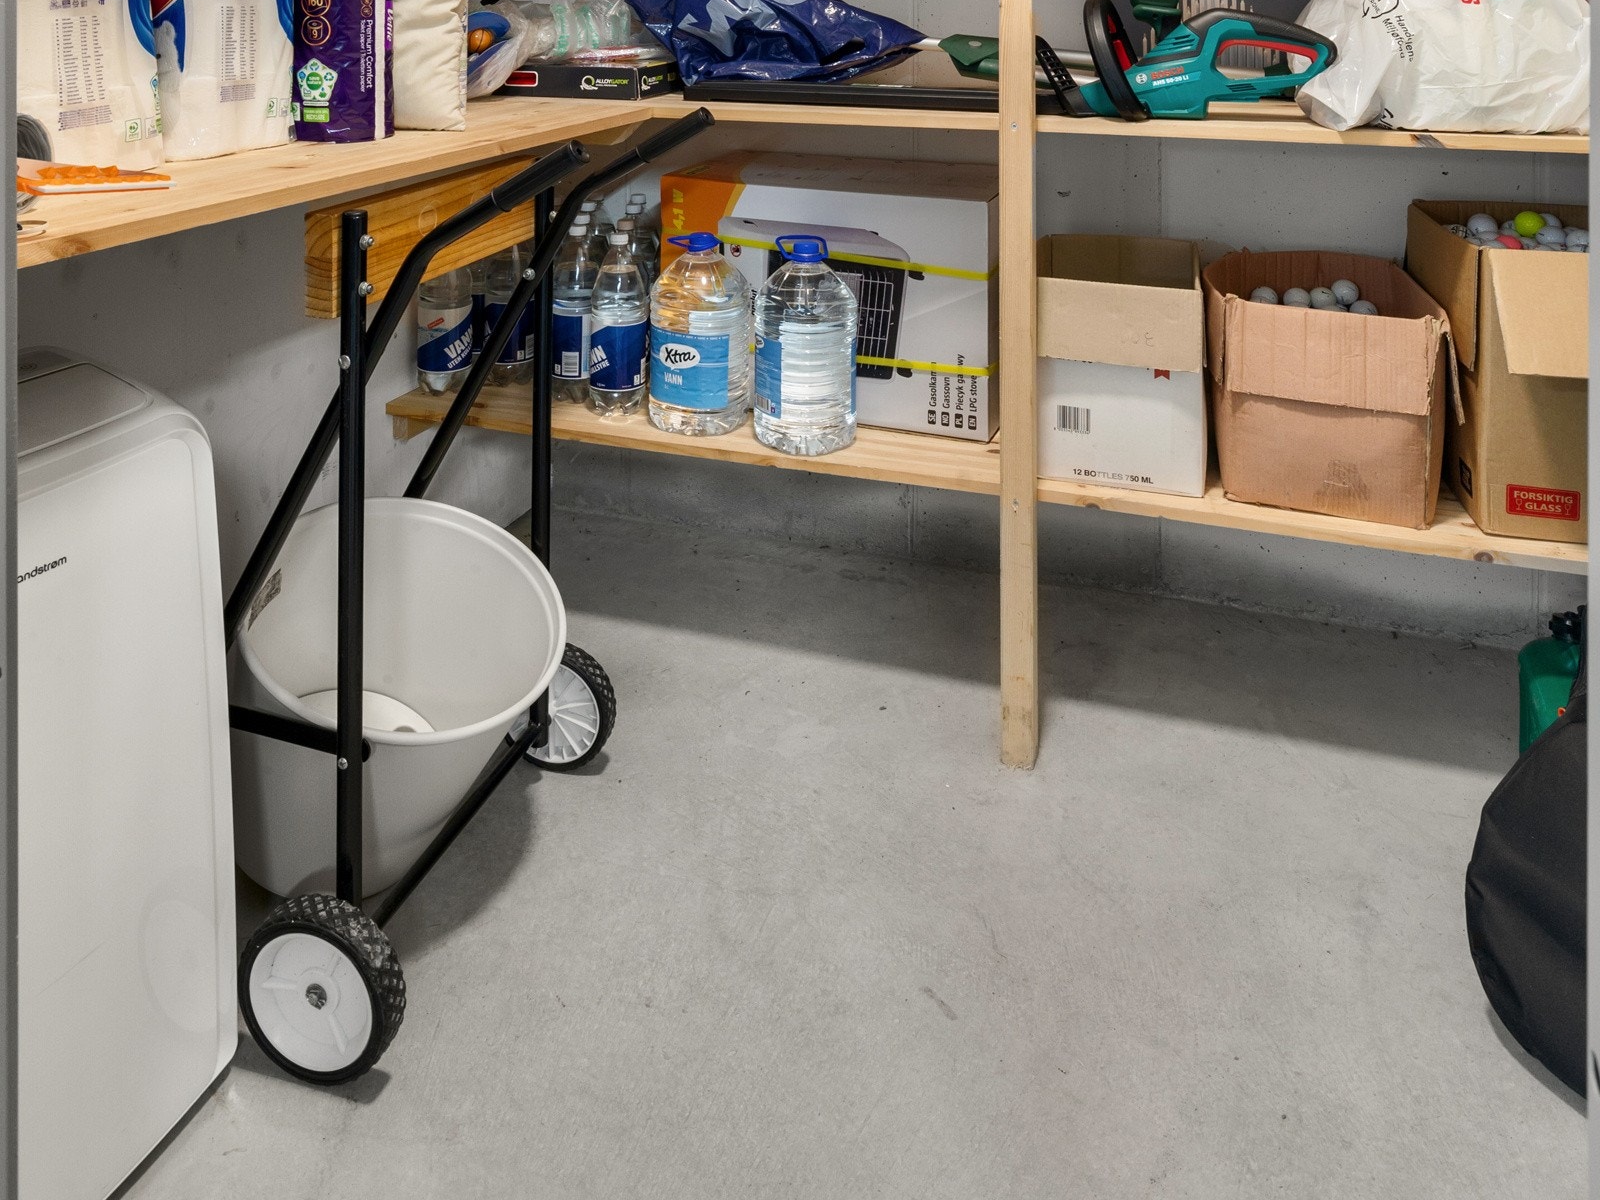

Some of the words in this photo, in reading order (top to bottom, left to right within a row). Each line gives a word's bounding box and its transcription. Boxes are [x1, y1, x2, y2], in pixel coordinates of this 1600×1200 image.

[312, 28, 319, 39] 9
[366, 19, 374, 55] Premium
[366, 56, 374, 89] Comfort
[1151, 65, 1185, 80] BOSCH
[1152, 79, 1166, 87] AHS
[447, 354, 463, 369] UTEN
[664, 346, 696, 365] Xtra
[957, 353, 966, 384] gawy
[664, 371, 683, 386] VANN
[969, 374, 978, 397] stove
[942, 376, 951, 409] Gassovn
[955, 385, 966, 411] Piecyk
[969, 397, 978, 413] LPG
[927, 411, 936, 424] SE
[941, 413, 950, 426] NO
[1073, 468, 1082, 476] 12
[1084, 469, 1123, 481] BOTTLES
[1125, 474, 1139, 483] 750
[1141, 476, 1154, 485] ML
[1513, 490, 1574, 505] FORSIKTIG
[1525, 501, 1562, 513] GLASS
[17, 555, 67, 584] andstrøm
